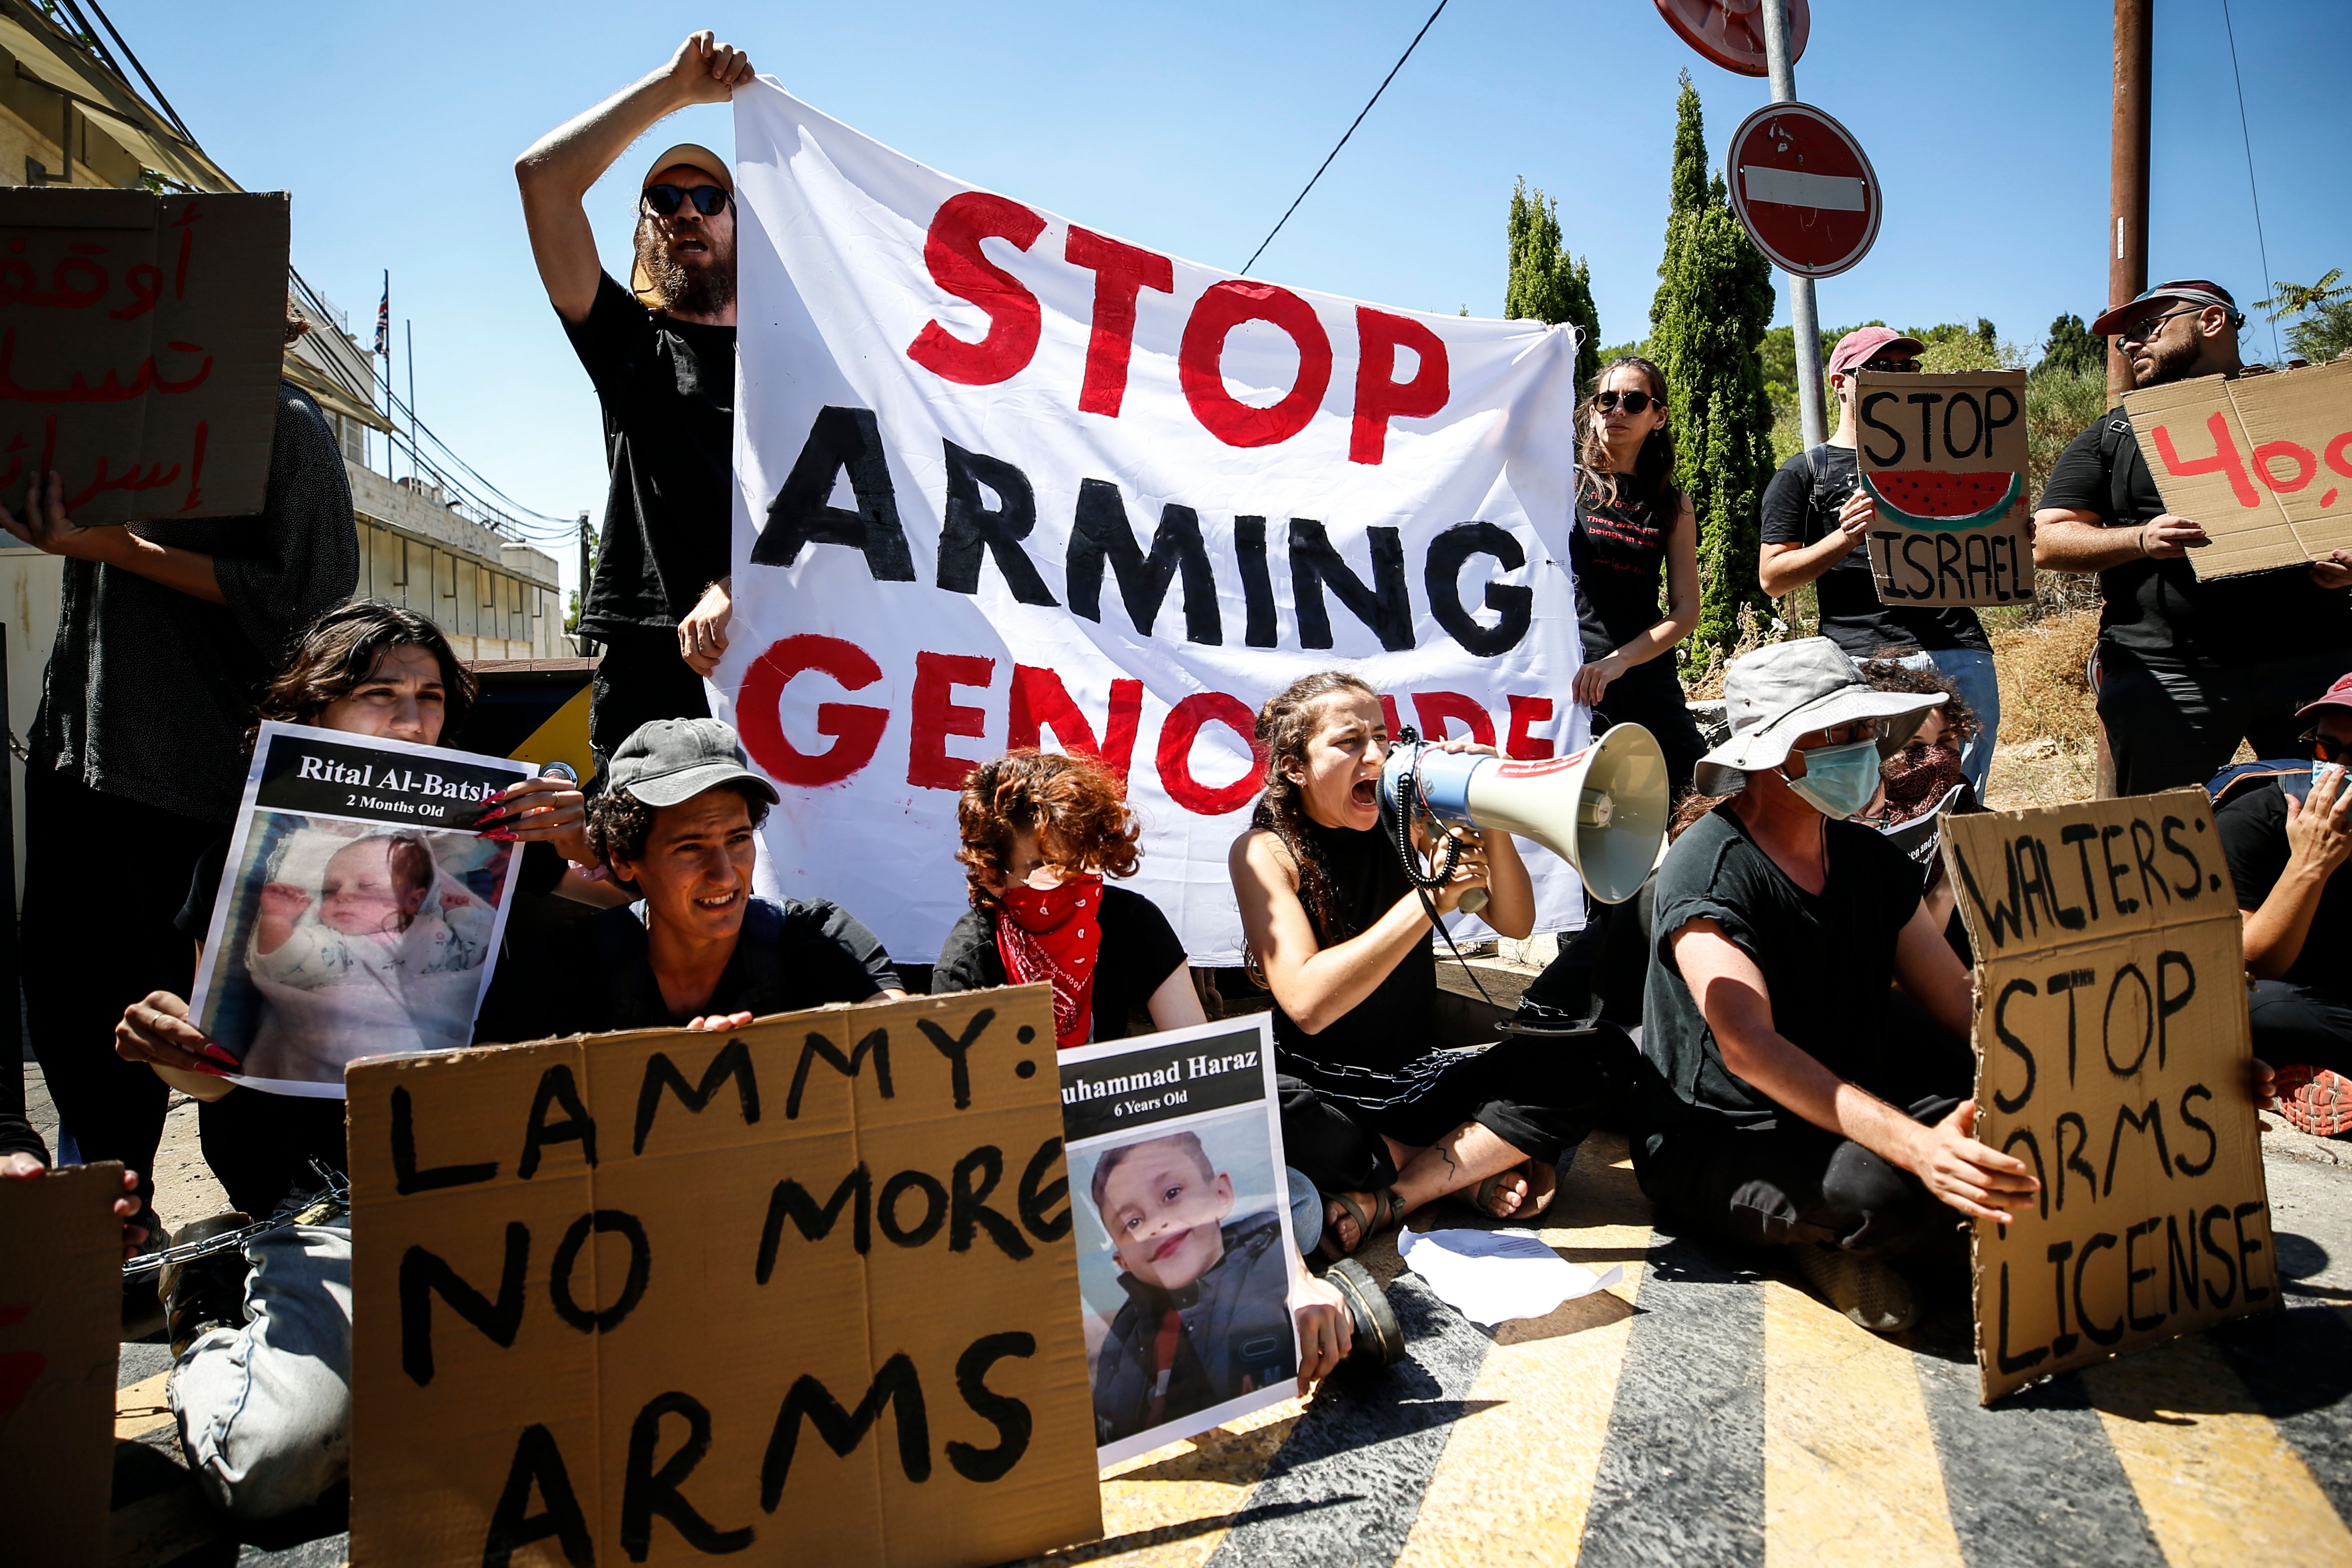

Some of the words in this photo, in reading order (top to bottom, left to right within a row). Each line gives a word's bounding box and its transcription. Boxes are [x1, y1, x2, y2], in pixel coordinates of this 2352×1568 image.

[906, 190, 1451, 465] STOP
[1860, 387, 2019, 467] STOP
[750, 405, 1533, 657] ARMING
[1586, 515, 1614, 526] There
[1616, 521, 1633, 530] are
[1589, 527, 1623, 539] beings
[1625, 535, 1636, 543] in
[1872, 531, 2033, 602] ISRAEL
[297, 755, 372, 787] Rital
[377, 768, 496, 803] Al-Batsh
[346, 795, 355, 806] 2
[360, 796, 415, 815] Months
[419, 803, 444, 818] Old
[1907, 848, 1920, 860] en
[1920, 836, 1932, 854] and
[1954, 815, 2222, 948] WALTERS:
[1061, 1060, 1180, 1104] uhammad
[1188, 1049, 1258, 1080] Haraz
[1994, 950, 2196, 1115] STOP
[391, 1008, 1035, 1195] LAMMY:
[1114, 1105, 1122, 1117] 6
[1124, 1099, 1161, 1115] Years
[1163, 1090, 1188, 1105] Old
[1998, 1084, 2217, 1241] ARMS
[400, 1209, 651, 1387] NO
[755, 1136, 1073, 1284] MORE
[1997, 1201, 2272, 1377] LICENSE
[481, 1331, 1036, 1568] ARMS
